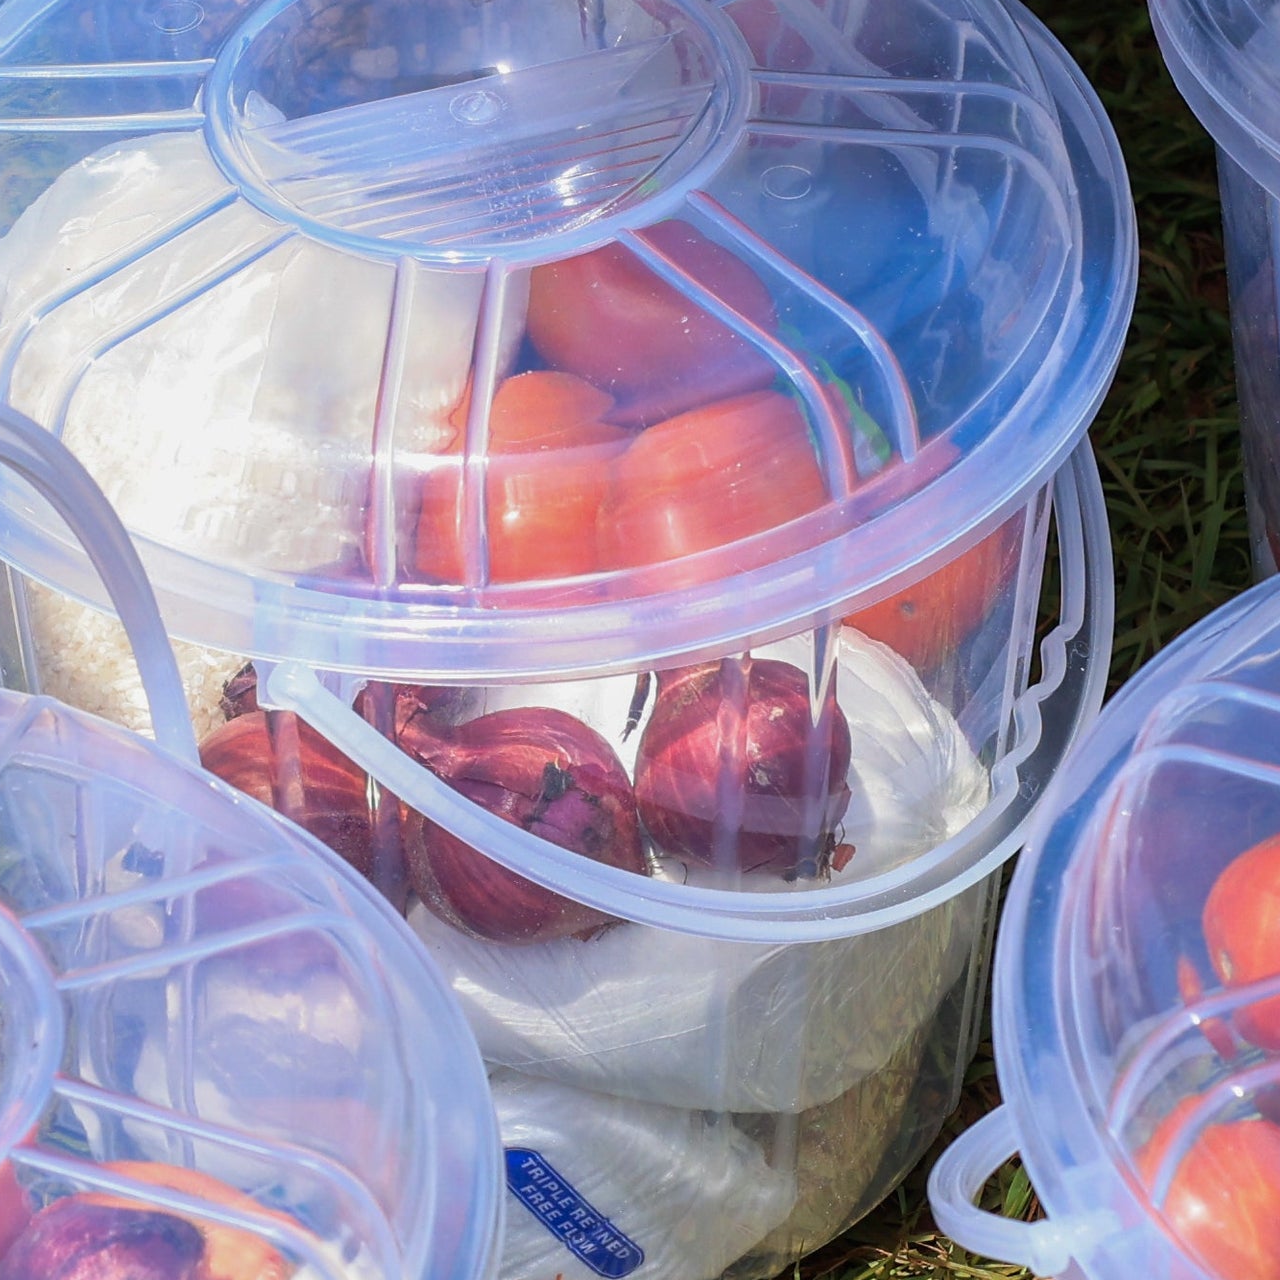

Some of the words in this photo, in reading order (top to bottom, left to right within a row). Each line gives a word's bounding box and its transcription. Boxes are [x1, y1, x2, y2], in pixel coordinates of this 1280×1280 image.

[520, 1156, 575, 1210] TRIPLE
[519, 1183, 562, 1222] FREE
[556, 1219, 598, 1255] FLOW
